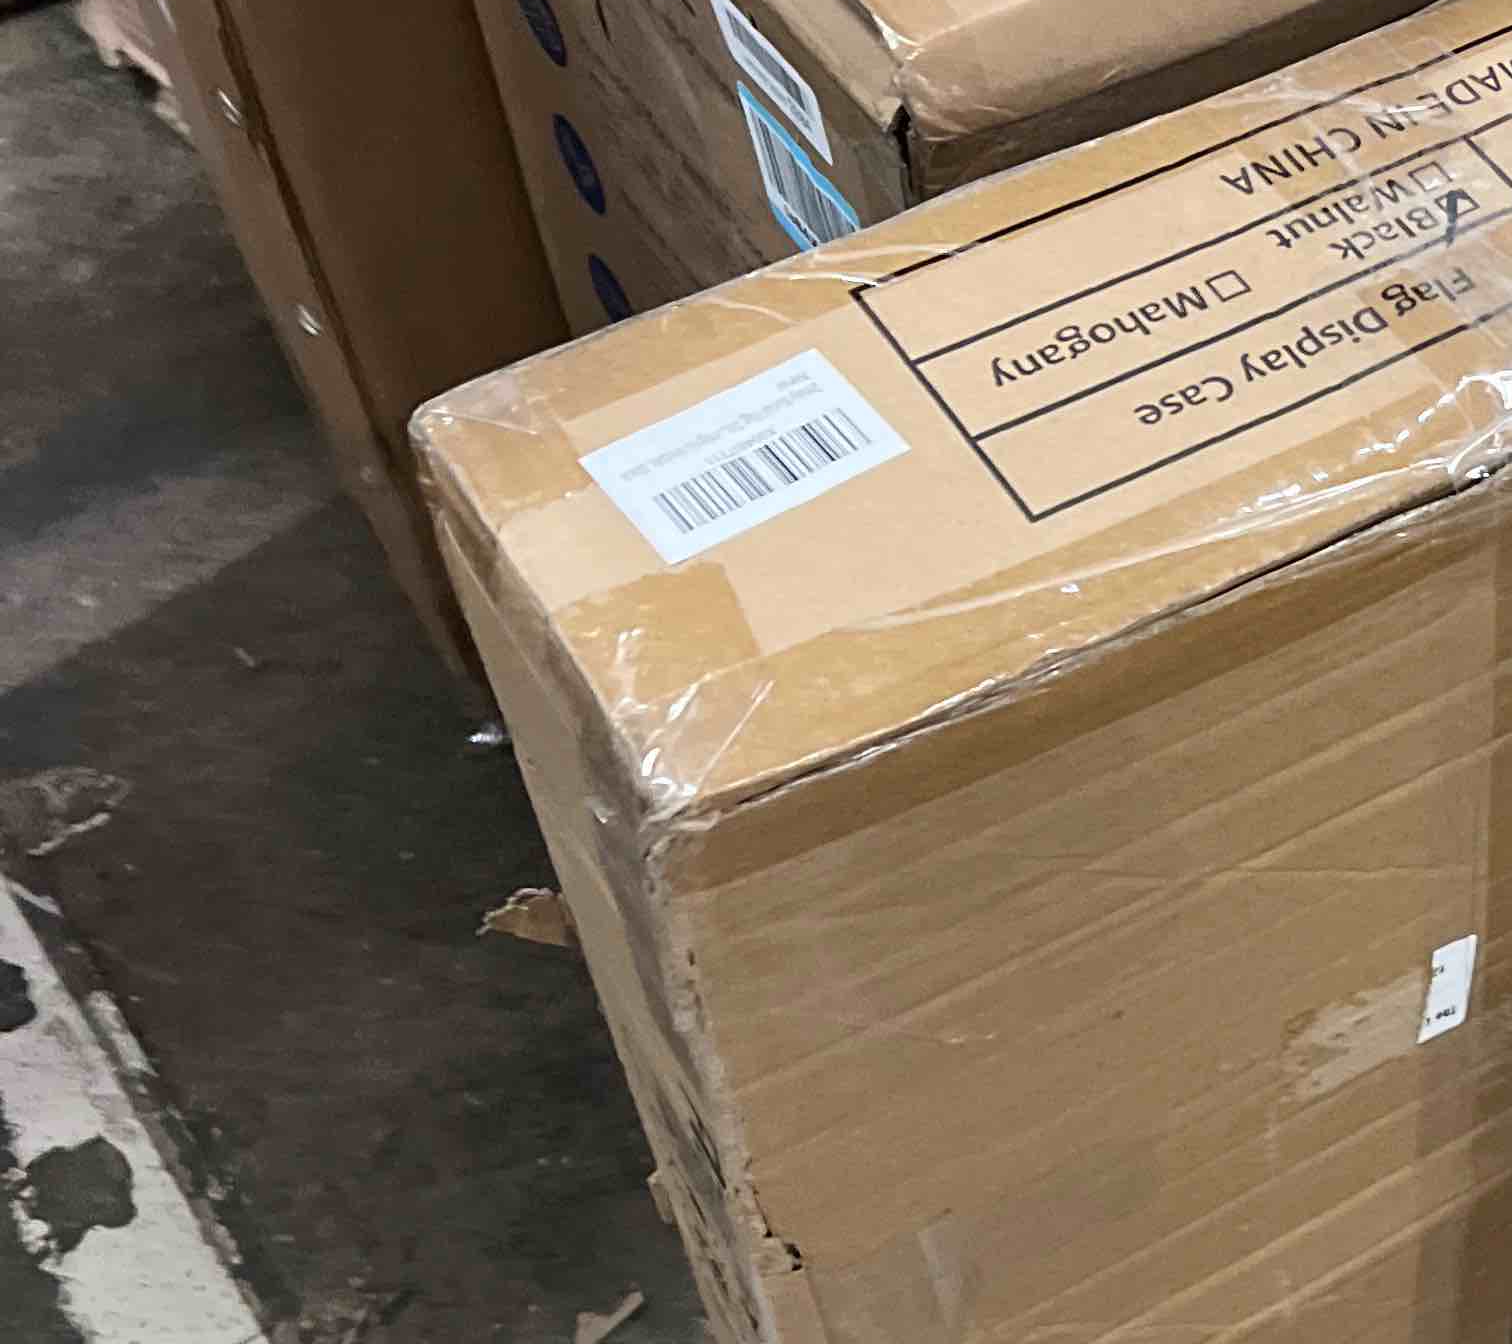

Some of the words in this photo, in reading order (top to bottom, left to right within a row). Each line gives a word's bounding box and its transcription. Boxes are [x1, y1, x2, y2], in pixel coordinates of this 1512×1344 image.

[1364, 102, 1420, 139] IN
[1219, 127, 1362, 195] CHINA
[1265, 177, 1414, 248] Walnut
[1327, 206, 1440, 260] Black
[1380, 266, 1477, 317] Flag
[990, 286, 1209, 387] Mahogany
[1240, 306, 1390, 381] Display
[1133, 375, 1234, 425] Case
